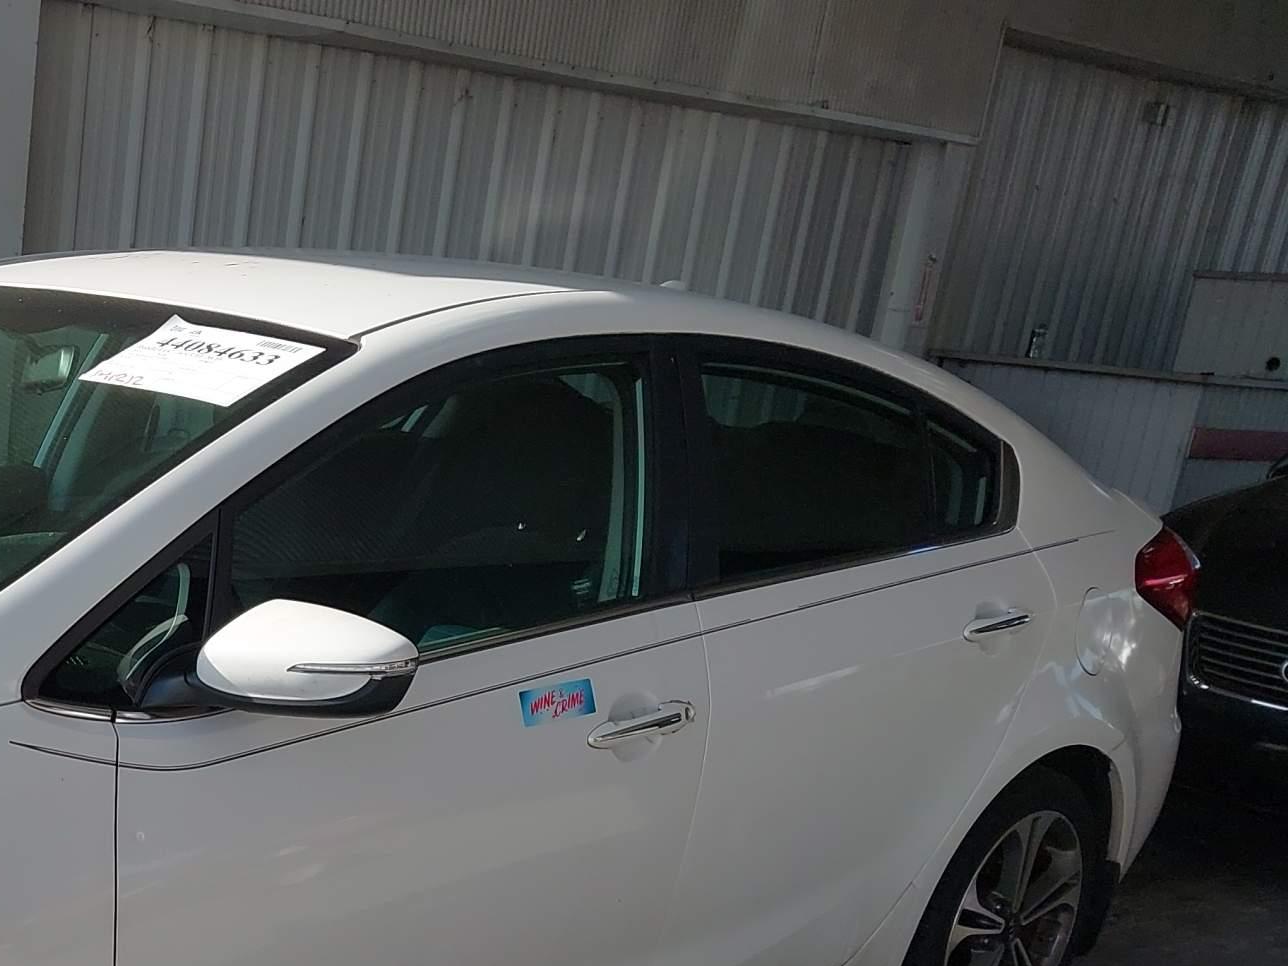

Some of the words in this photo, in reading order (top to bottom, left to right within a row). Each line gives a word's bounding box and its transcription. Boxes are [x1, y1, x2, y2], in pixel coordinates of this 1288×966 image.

[157, 337, 281, 365] 44084633
[530, 690, 557, 716] WINE
[553, 691, 585, 717] CRIME
